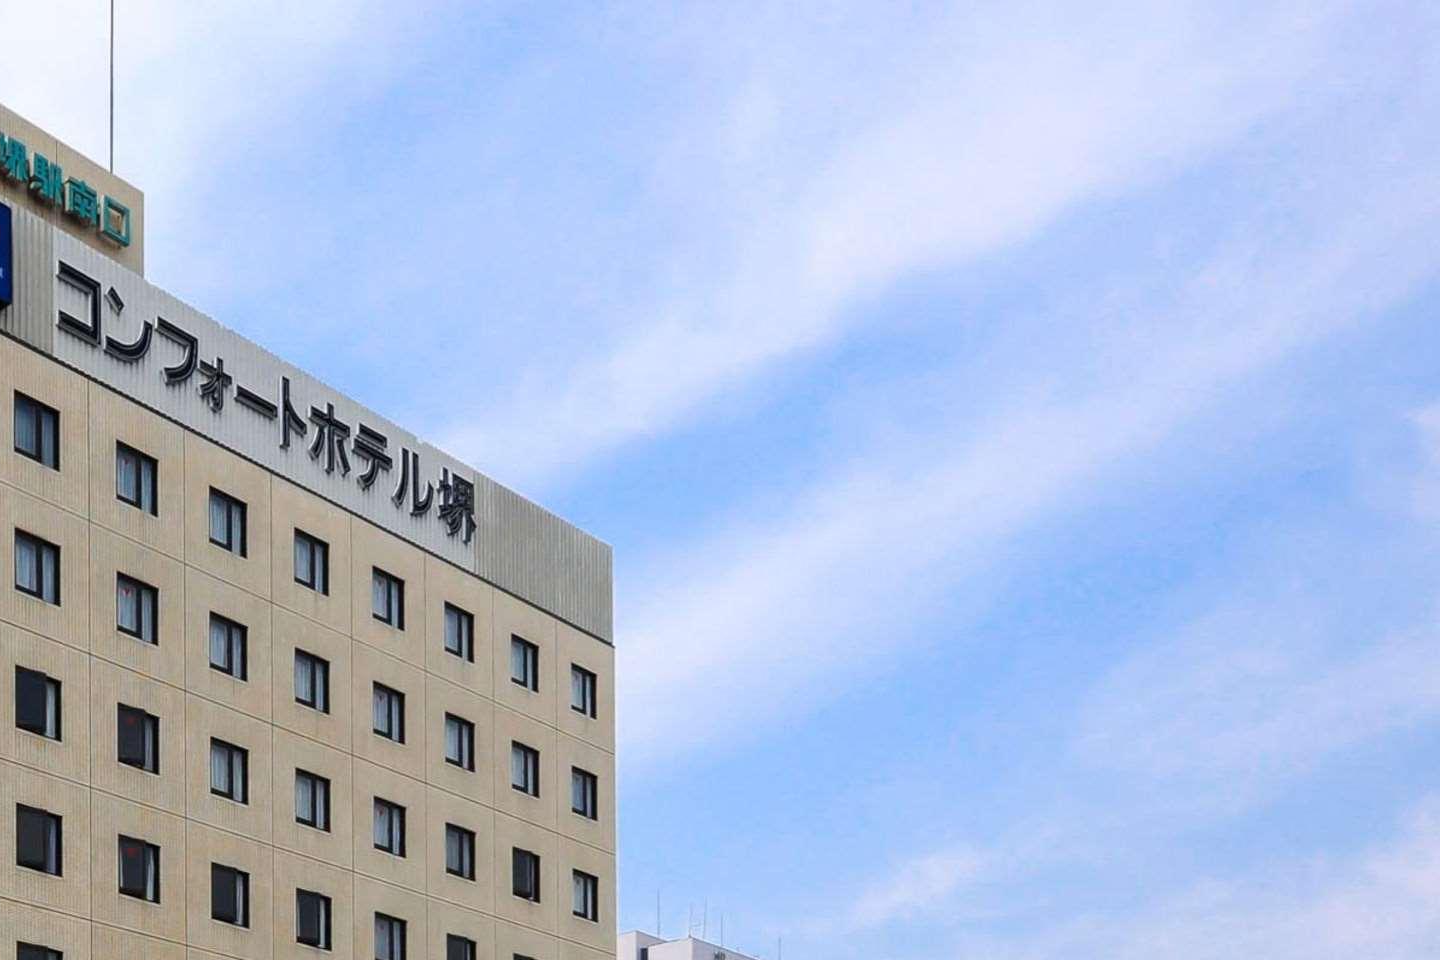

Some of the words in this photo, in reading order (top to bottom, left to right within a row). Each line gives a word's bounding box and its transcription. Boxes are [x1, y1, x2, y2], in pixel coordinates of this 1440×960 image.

[56, 260, 477, 544] コンフォートホテル堺
